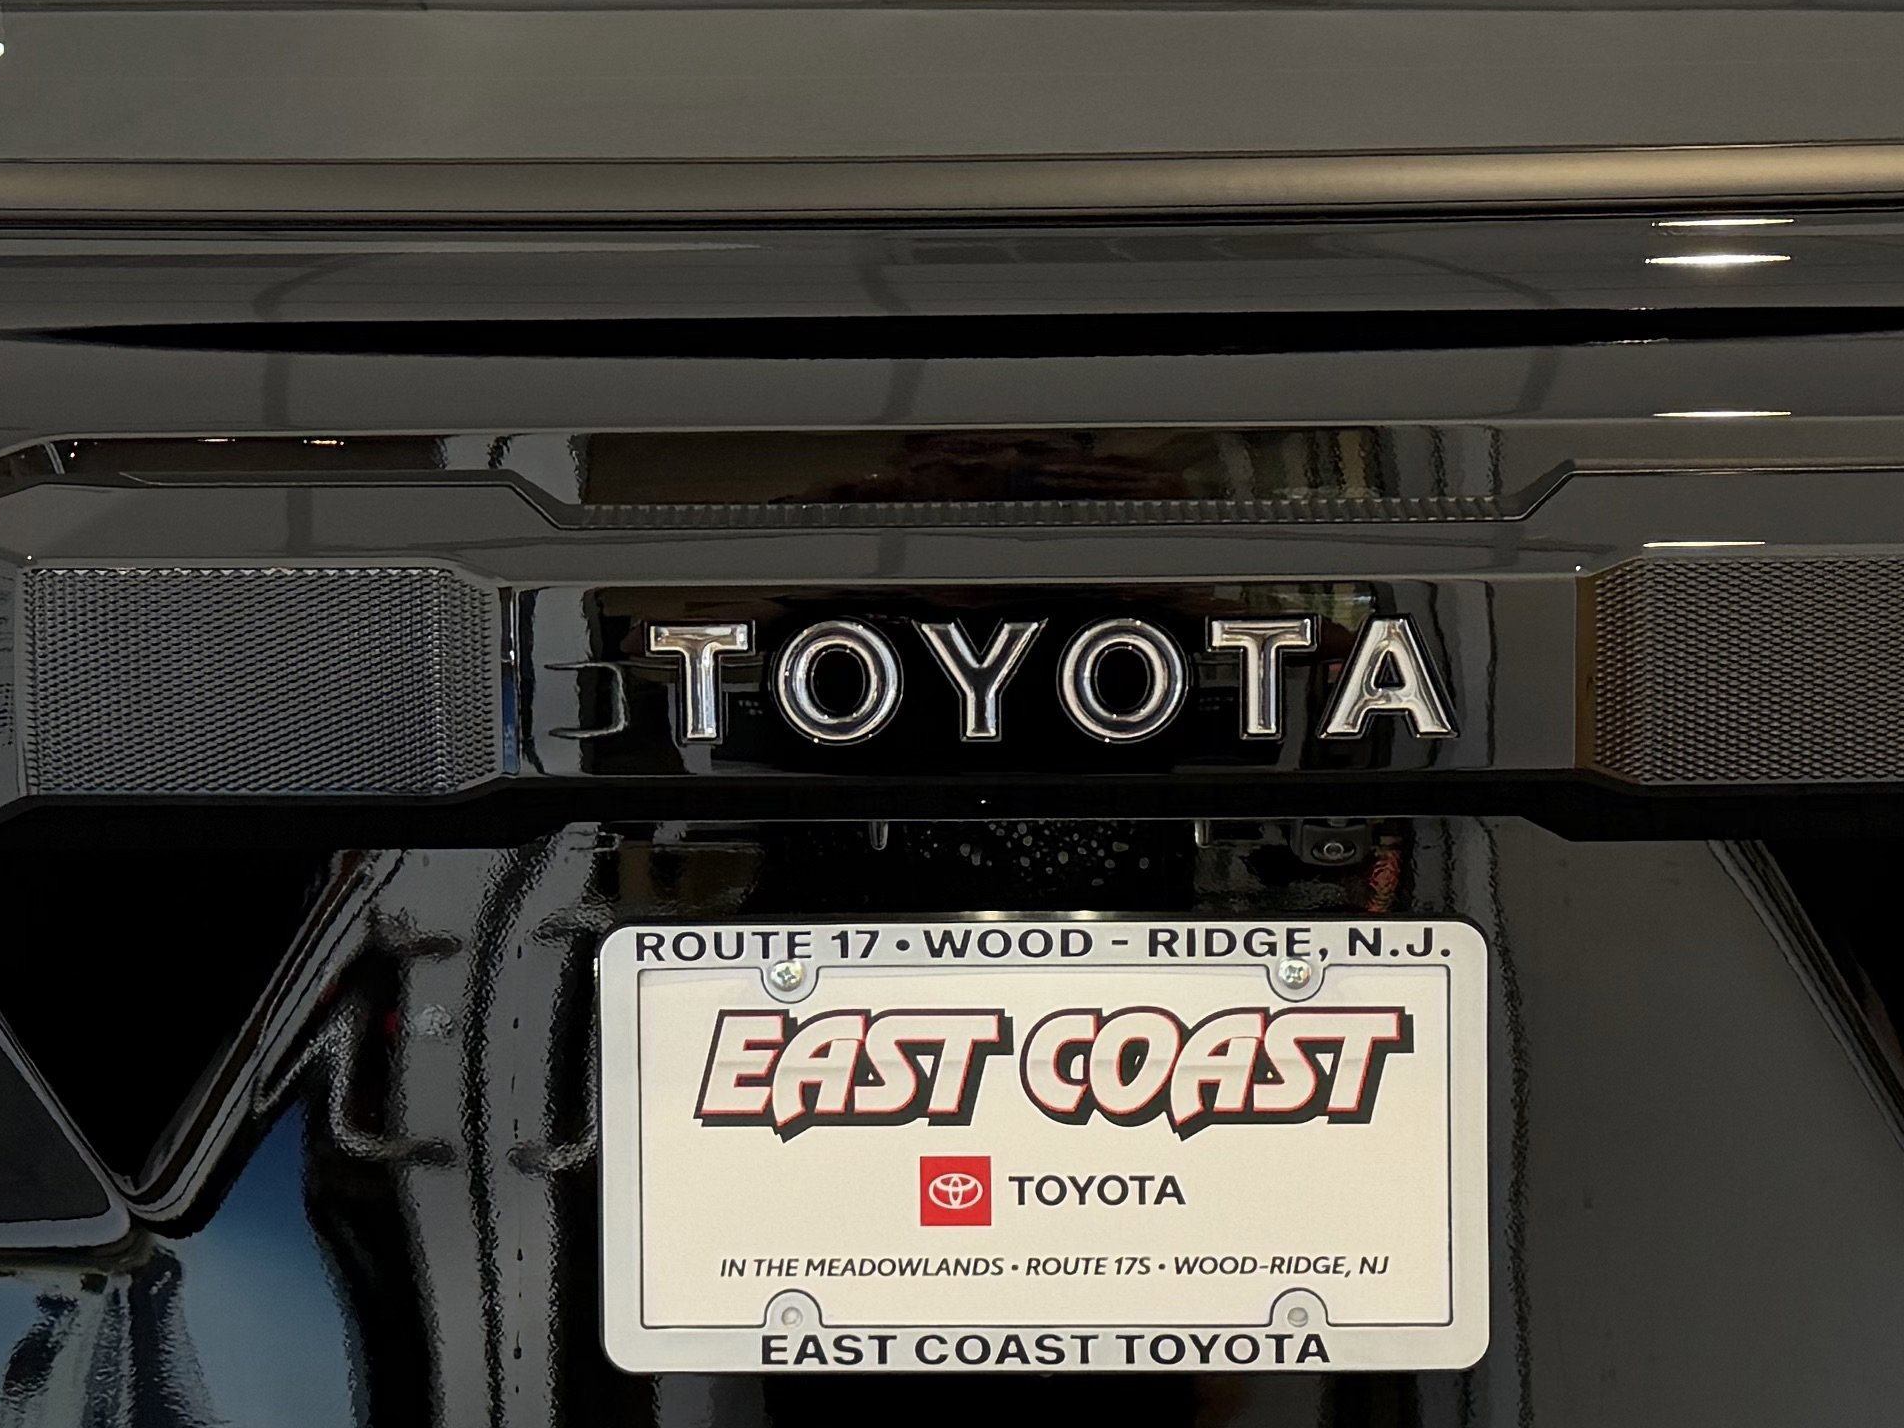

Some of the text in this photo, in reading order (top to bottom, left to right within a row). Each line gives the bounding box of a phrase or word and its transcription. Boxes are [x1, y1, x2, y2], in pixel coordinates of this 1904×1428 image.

[645, 614, 1460, 745] TOYOTA
[635, 929, 812, 962] ROUTE
[830, 929, 880, 960] 17
[923, 927, 1093, 960] WOOD
[1147, 927, 1329, 962] RIDGE,
[1348, 927, 1451, 958] N.J.
[693, 1005, 1414, 1143] EAST COAST
[1008, 1174, 1186, 1208] TOYOTA
[720, 1255, 1390, 1280] IN THE MEADOWLANDS ROUTE 17S WOOD-RIDGE, NJ
[761, 1332, 1332, 1367] EAST COAST TOYOTA
